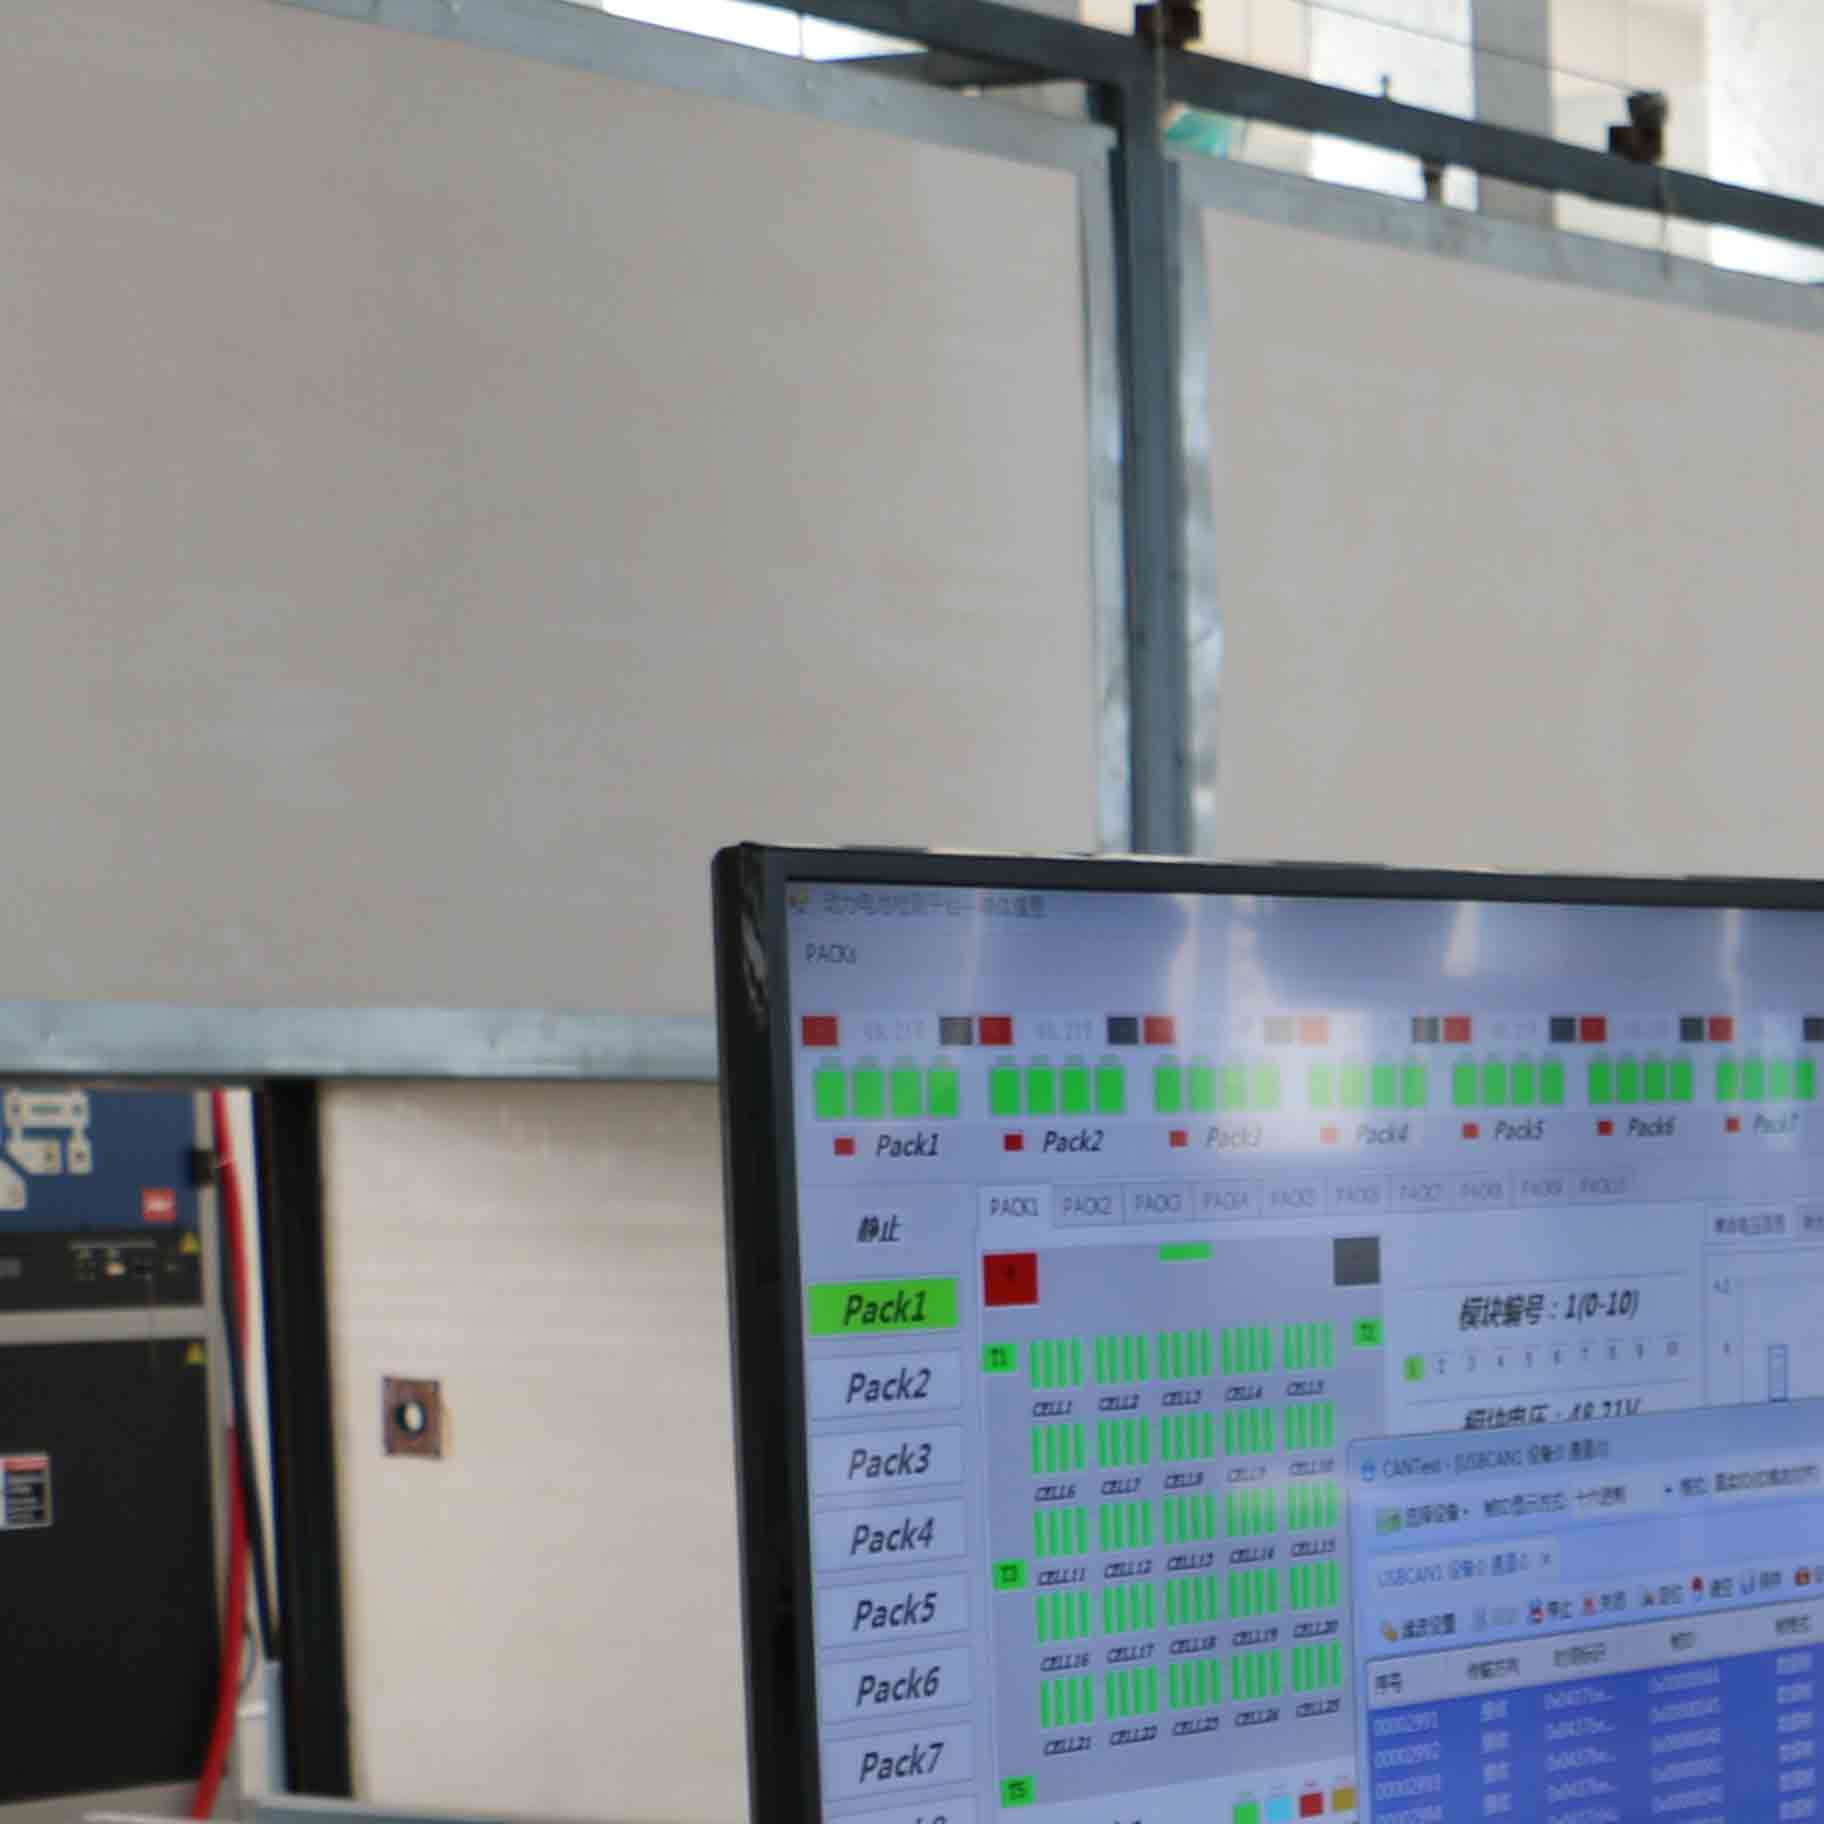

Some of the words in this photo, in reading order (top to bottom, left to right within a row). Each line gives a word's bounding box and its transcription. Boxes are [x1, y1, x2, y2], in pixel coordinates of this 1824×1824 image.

[1042, 1129, 1103, 1154] Pack2
[1494, 1119, 1545, 1144] Pack5
[1626, 1115, 1677, 1139] Pack6
[876, 1132, 939, 1159] Pack1
[843, 1290, 928, 1327] Pack1
[846, 1369, 931, 1404] Pack2
[848, 1445, 931, 1480] Pack3
[850, 1520, 934, 1556] Pack4
[853, 1593, 937, 1631] Pack5
[855, 1667, 940, 1706] Pack6
[859, 1743, 944, 1784] Pack7
